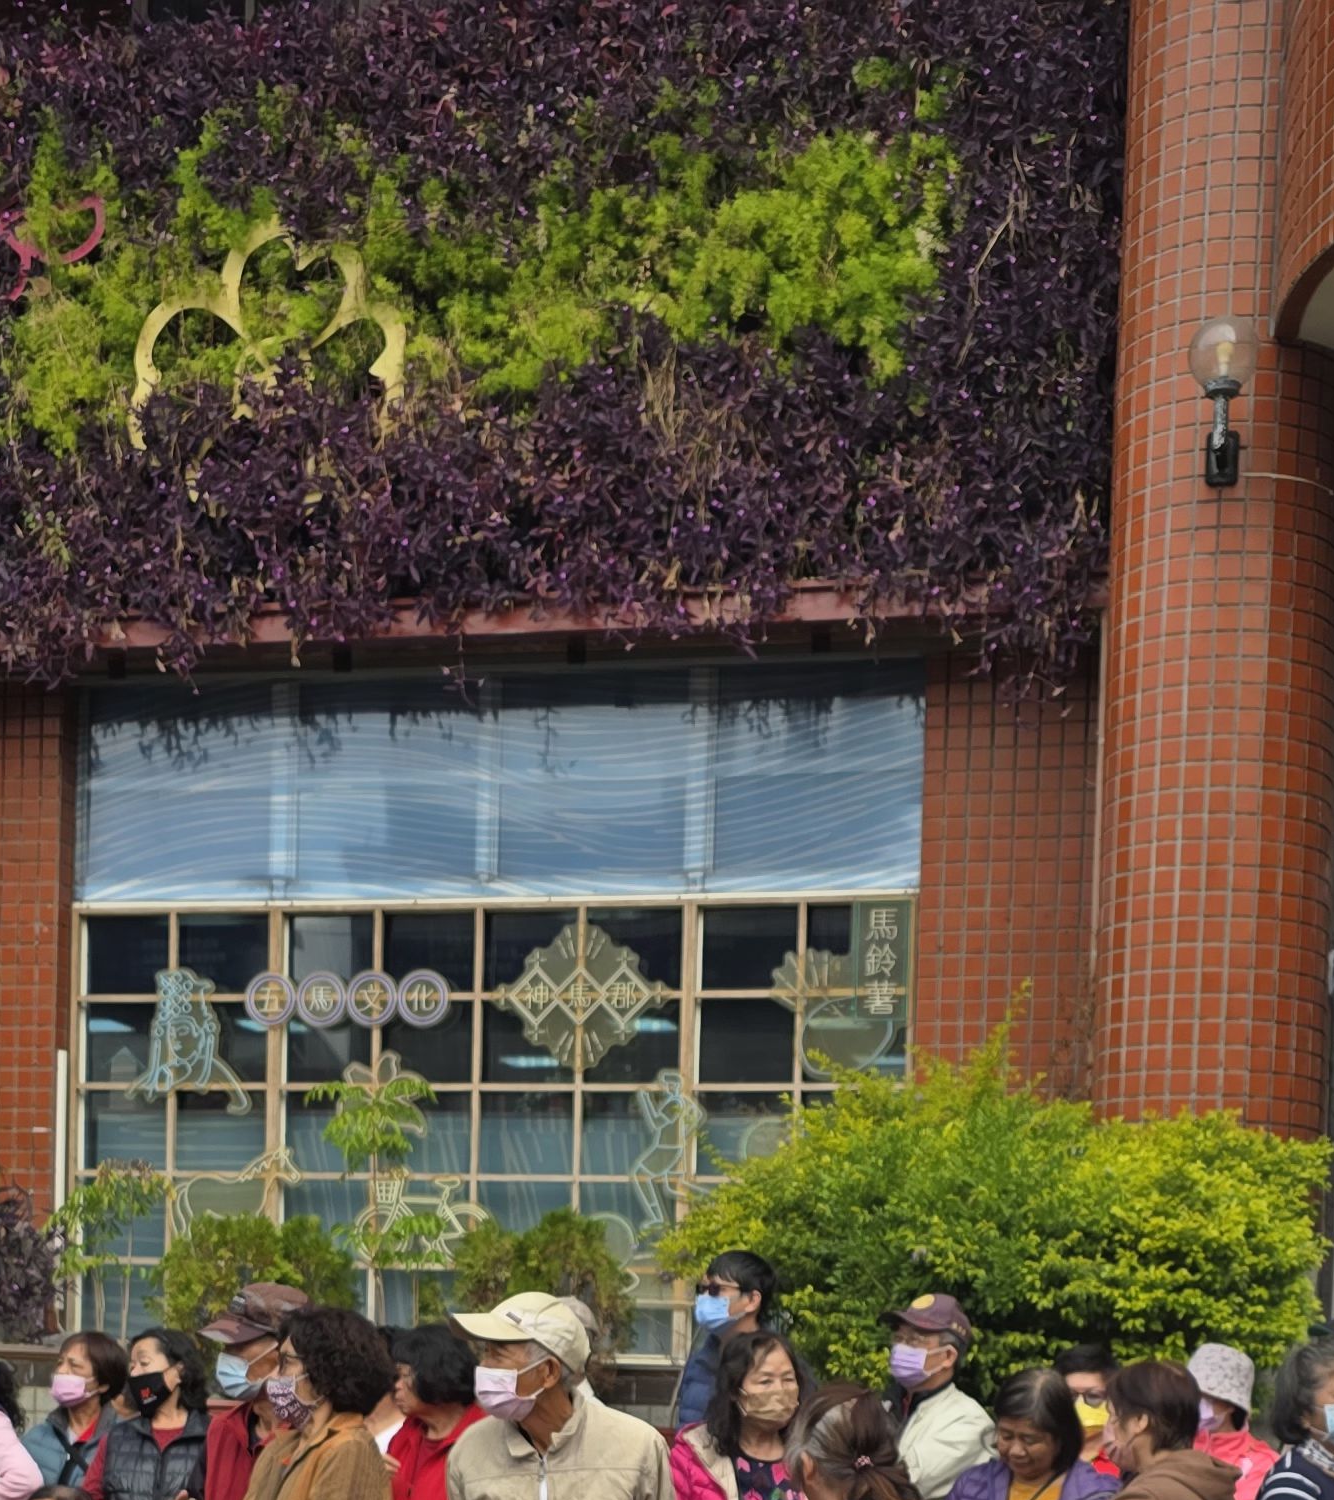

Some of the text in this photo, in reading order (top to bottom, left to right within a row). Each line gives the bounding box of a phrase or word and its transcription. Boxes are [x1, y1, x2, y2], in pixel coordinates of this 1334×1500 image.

[864, 908, 899, 1015] 馬鈴薯
[259, 986, 437, 1012] 五馬文化
[525, 981, 637, 1010] 神馬郡
